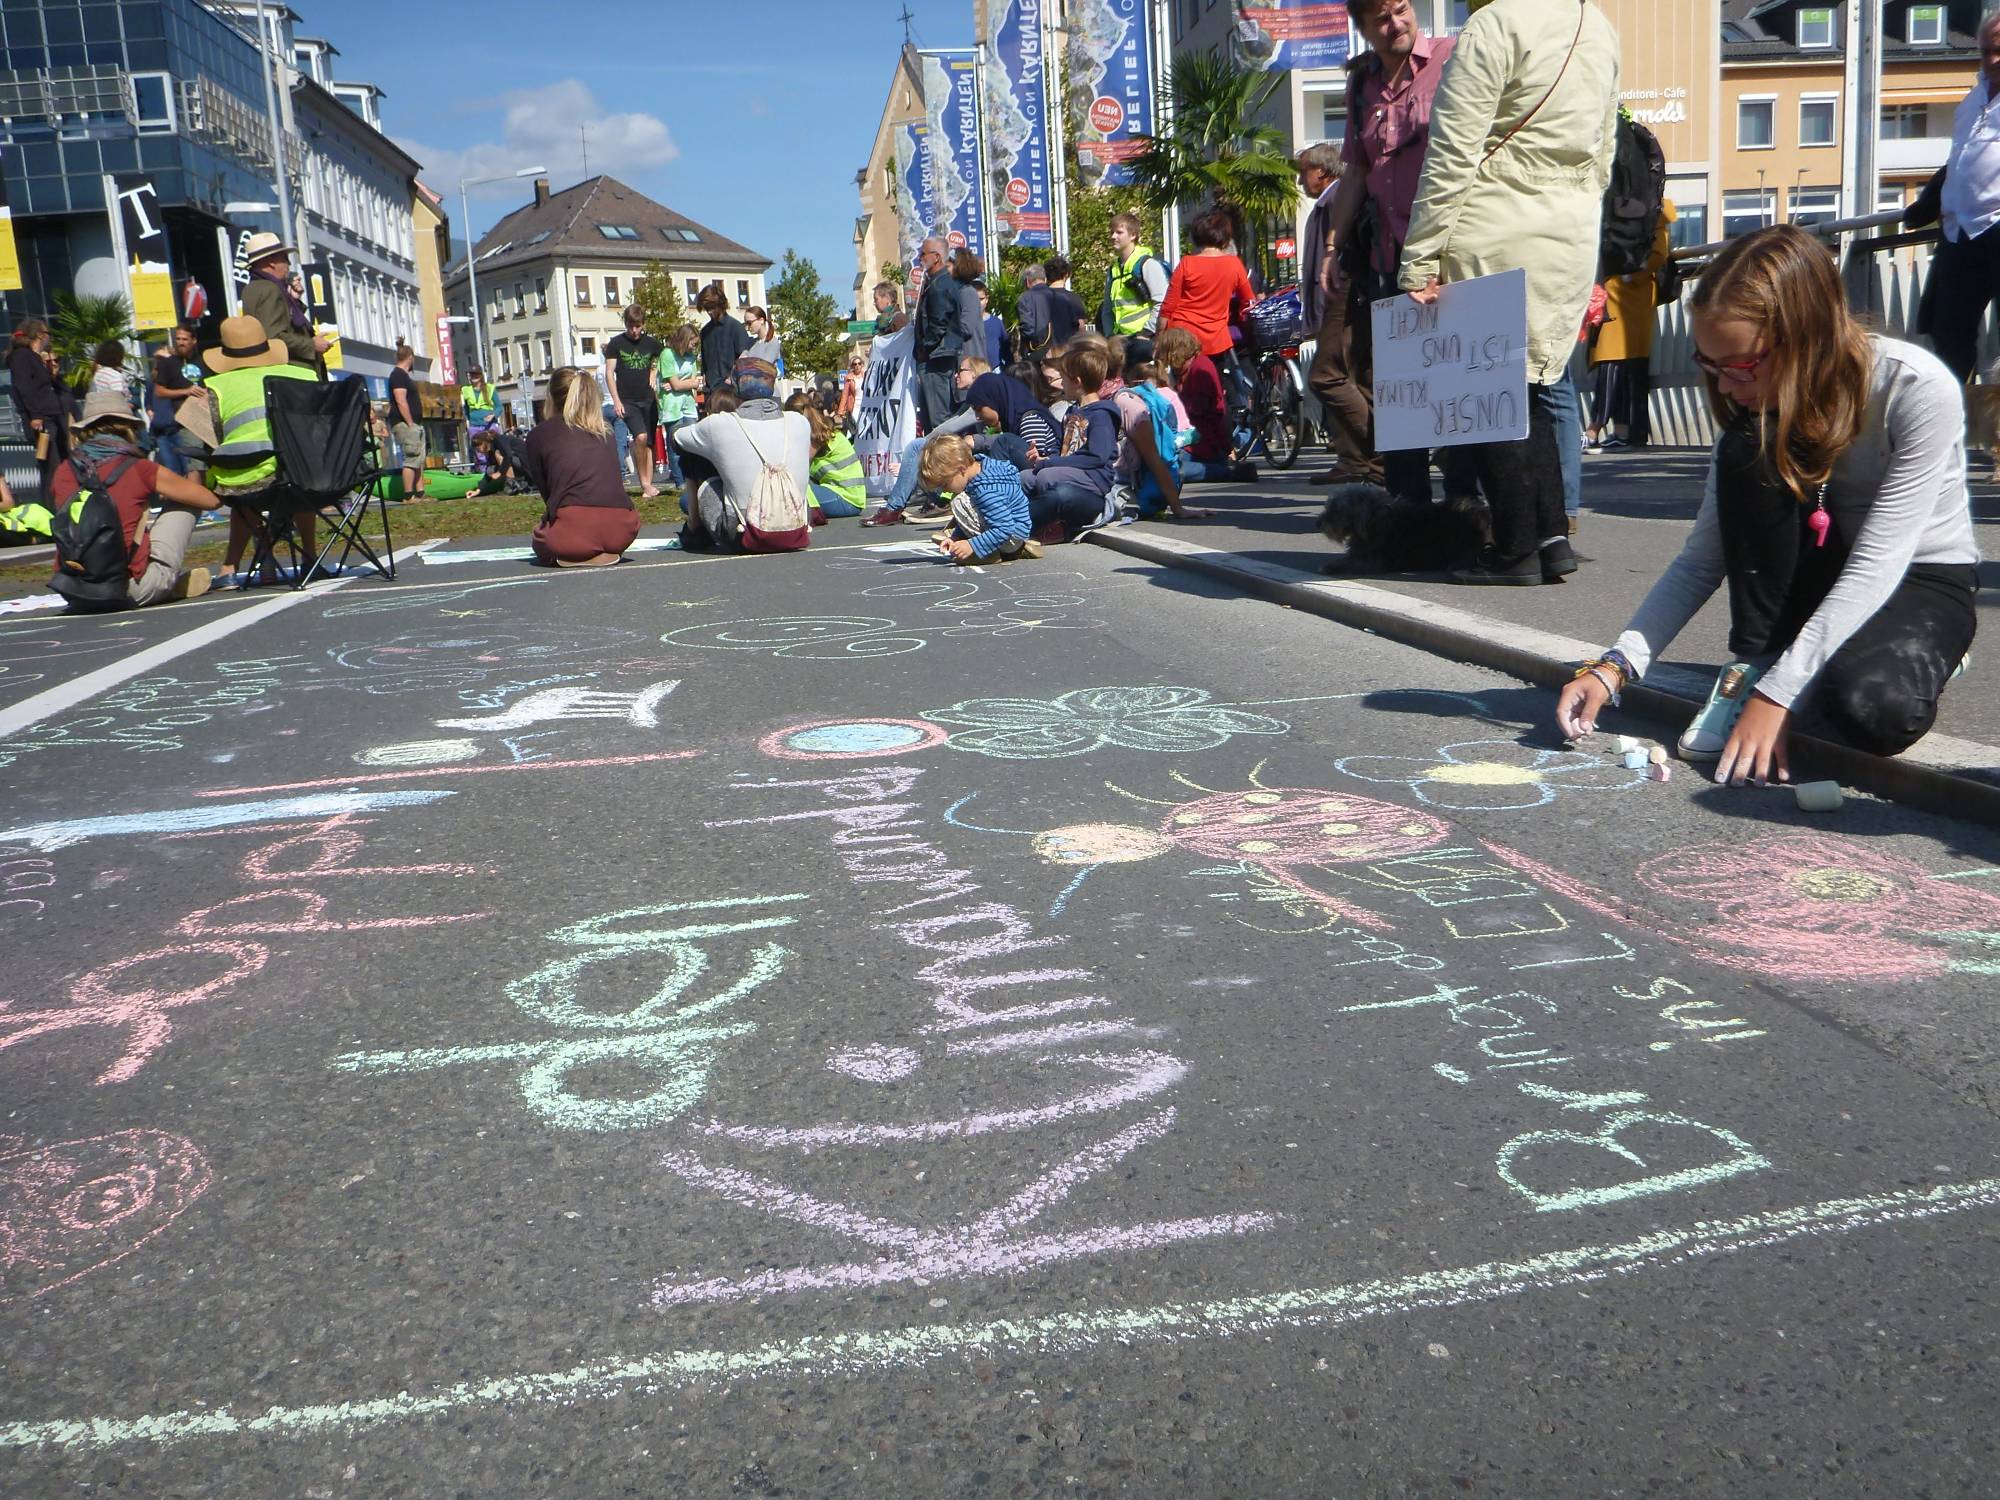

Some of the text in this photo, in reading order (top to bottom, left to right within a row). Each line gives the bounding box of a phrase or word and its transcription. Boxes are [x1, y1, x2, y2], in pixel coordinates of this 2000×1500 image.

[1631, 101, 1686, 123] rnold
[1388, 303, 1439, 339] NICHT
[1422, 332, 1510, 373] IST UNS
[1375, 380, 1516, 436] UNSER KLIMA
[1324, 926, 1445, 971] das
[332, 892, 811, 1134] den
[650, 765, 1286, 1308] Klimawandel
[1610, 975, 1768, 1052] ins
[1335, 981, 1773, 1214] Bringt
